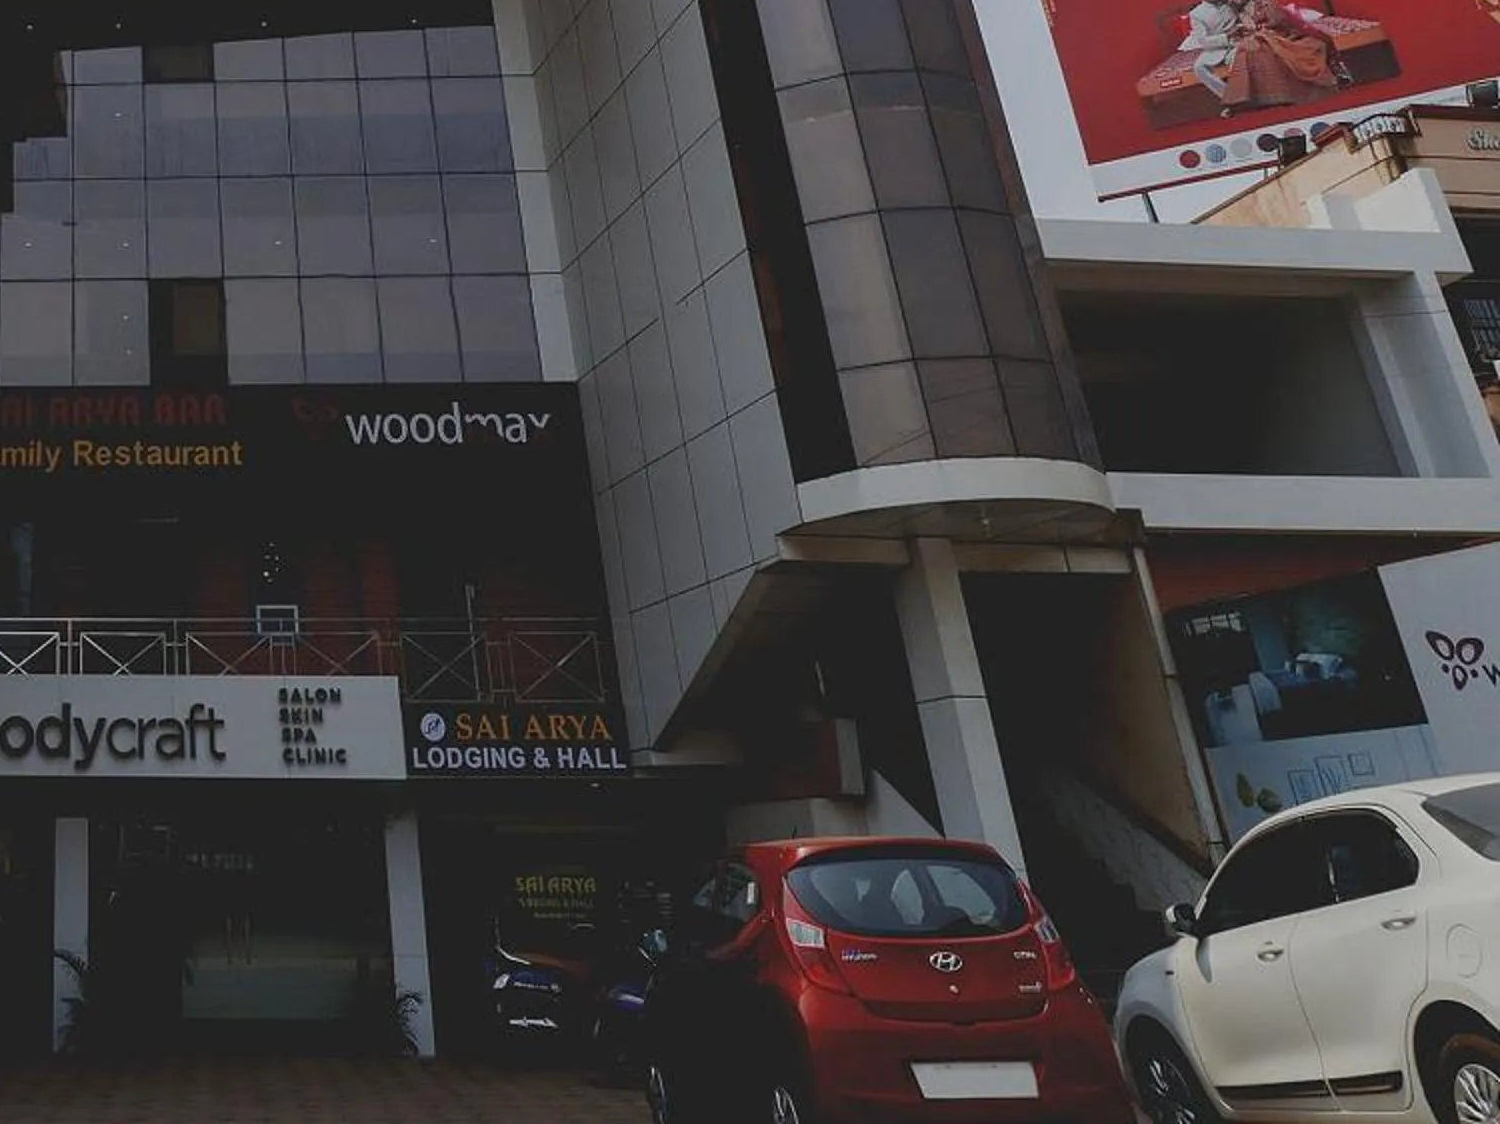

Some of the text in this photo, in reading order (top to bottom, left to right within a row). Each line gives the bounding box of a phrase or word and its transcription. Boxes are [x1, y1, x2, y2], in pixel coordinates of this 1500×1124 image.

[72, 439, 244, 467] Restaurant
[277, 687, 343, 705] SALON
[279, 707, 324, 724] SKIN
[281, 727, 317, 744] SPA
[455, 712, 614, 741] SAI ARYA
[282, 747, 347, 765] CLINIC
[412, 745, 628, 769] LODGING & HALL
[514, 876, 597, 893] SAI ARYA
